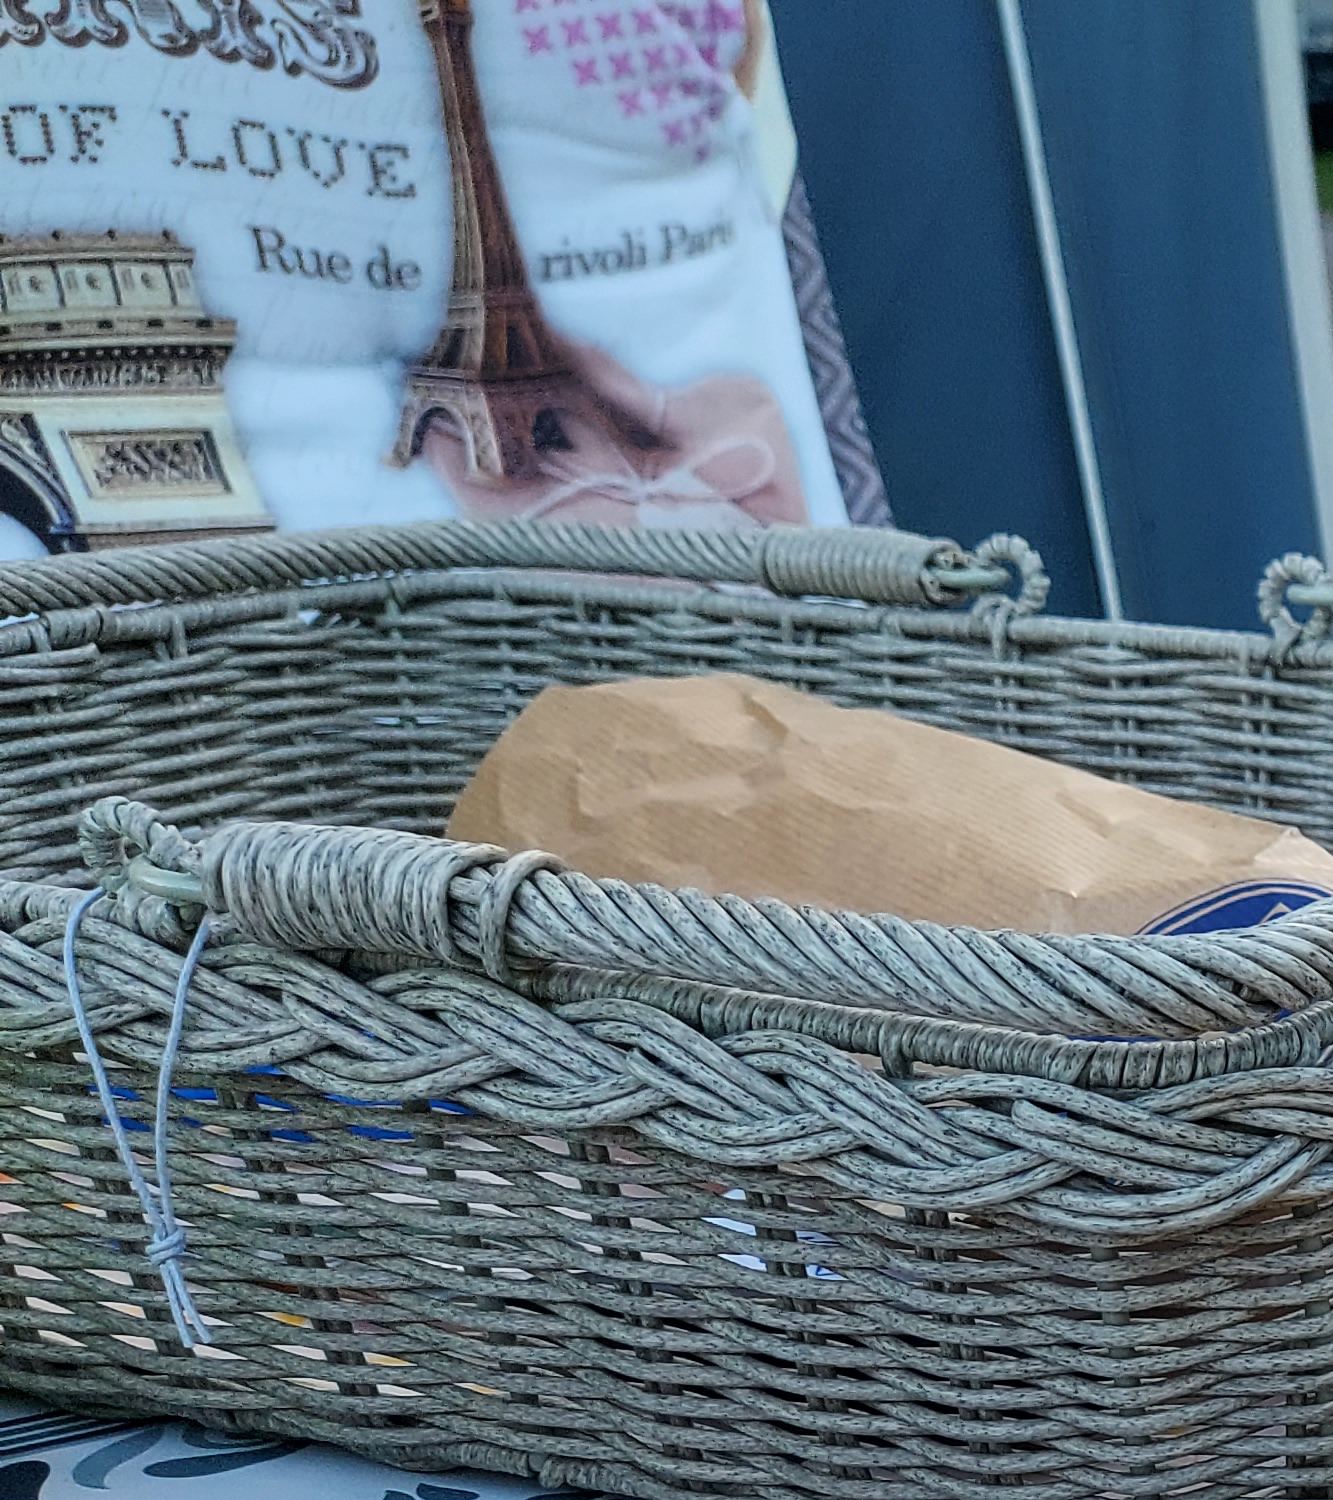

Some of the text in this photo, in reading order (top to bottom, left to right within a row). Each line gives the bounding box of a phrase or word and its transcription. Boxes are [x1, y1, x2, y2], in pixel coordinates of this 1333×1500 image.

[1, 104, 416, 198] OF LOVE
[248, 223, 353, 284] Rue
[366, 244, 422, 291] de
[540, 228, 647, 283] rivoli
